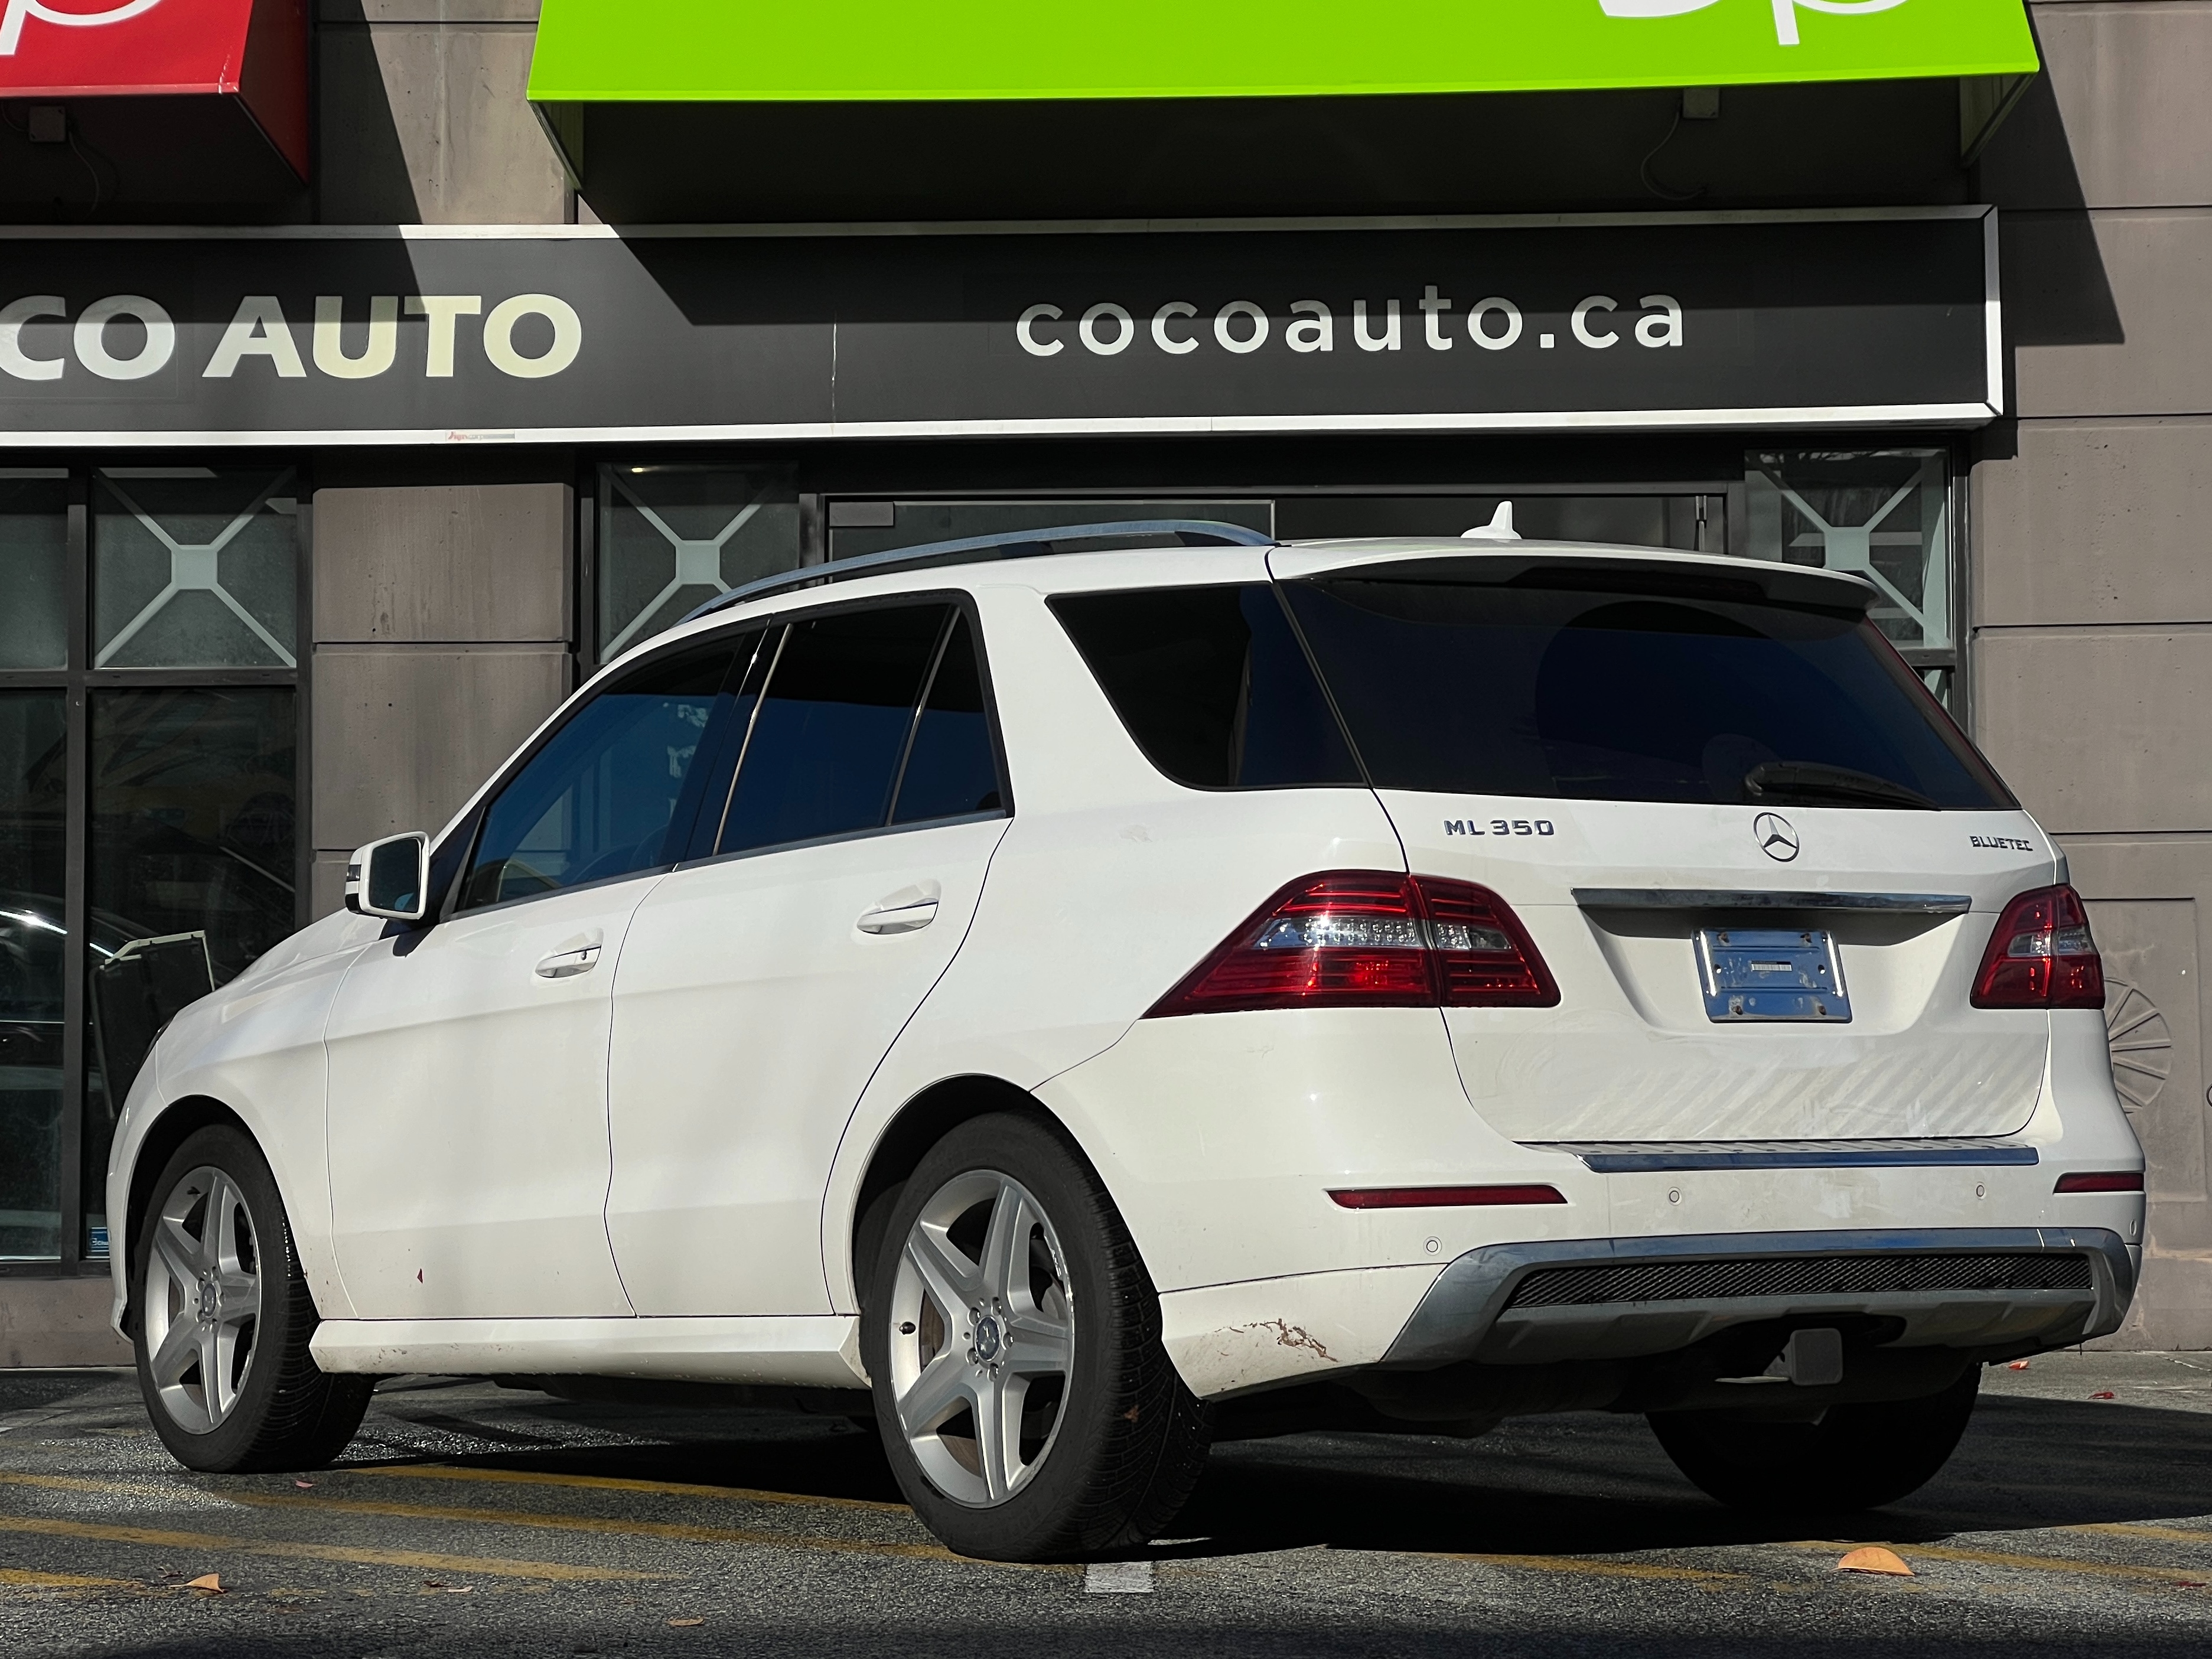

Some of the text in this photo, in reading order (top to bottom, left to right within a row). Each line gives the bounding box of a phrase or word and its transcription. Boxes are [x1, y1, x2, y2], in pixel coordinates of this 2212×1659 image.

[0, 294, 582, 380] CO AUTO
[1016, 285, 1683, 356] cocoauto.ca
[1444, 820, 1554, 836] ML 350
[1969, 836, 2033, 851] BLUETEC
